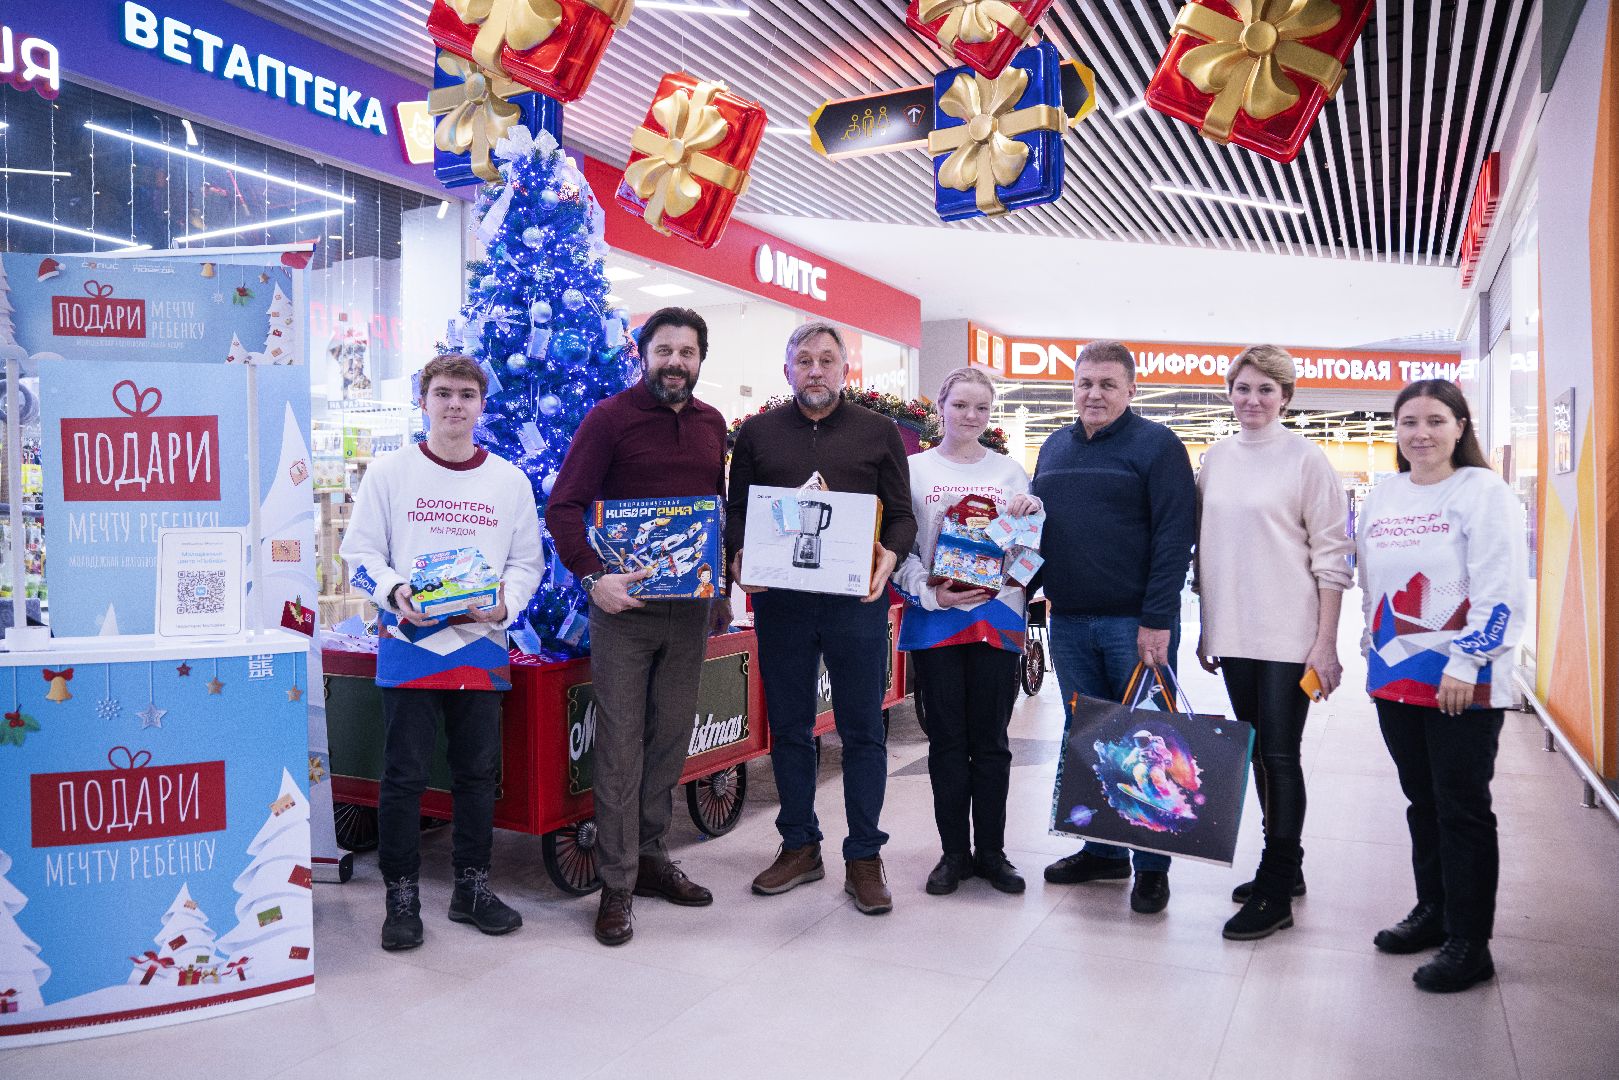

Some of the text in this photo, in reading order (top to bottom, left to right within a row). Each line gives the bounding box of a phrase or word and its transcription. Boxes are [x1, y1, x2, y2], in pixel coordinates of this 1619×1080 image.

[123, 1, 388, 135] ВЕТАПТЕКА
[775, 249, 827, 301] МТС
[59, 301, 196, 333] ПОДАРИ МЕЧТУ
[1011, 342, 1085, 375] DN
[1134, 351, 1239, 377] ЦИФРОВ
[1293, 357, 1391, 381] БЫТОВАЯ
[1399, 360, 1462, 382] ТЕХНИ
[73, 430, 212, 493] ПОДАРИ
[416, 498, 495, 514] ВОЛОНТЕРЫ
[933, 485, 1003, 495] ВОЛОНТЕРЫ
[68, 511, 130, 545] МЕЧТУ
[407, 510, 499, 528] ПОДМОСКОВЬЯ
[430, 526, 476, 536] МЫ РЯДОМ
[687, 713, 743, 756] istmas
[58, 772, 200, 834] ПОДАРИ
[45, 837, 217, 888] МЕЧТУ РЕБЁНКУ
